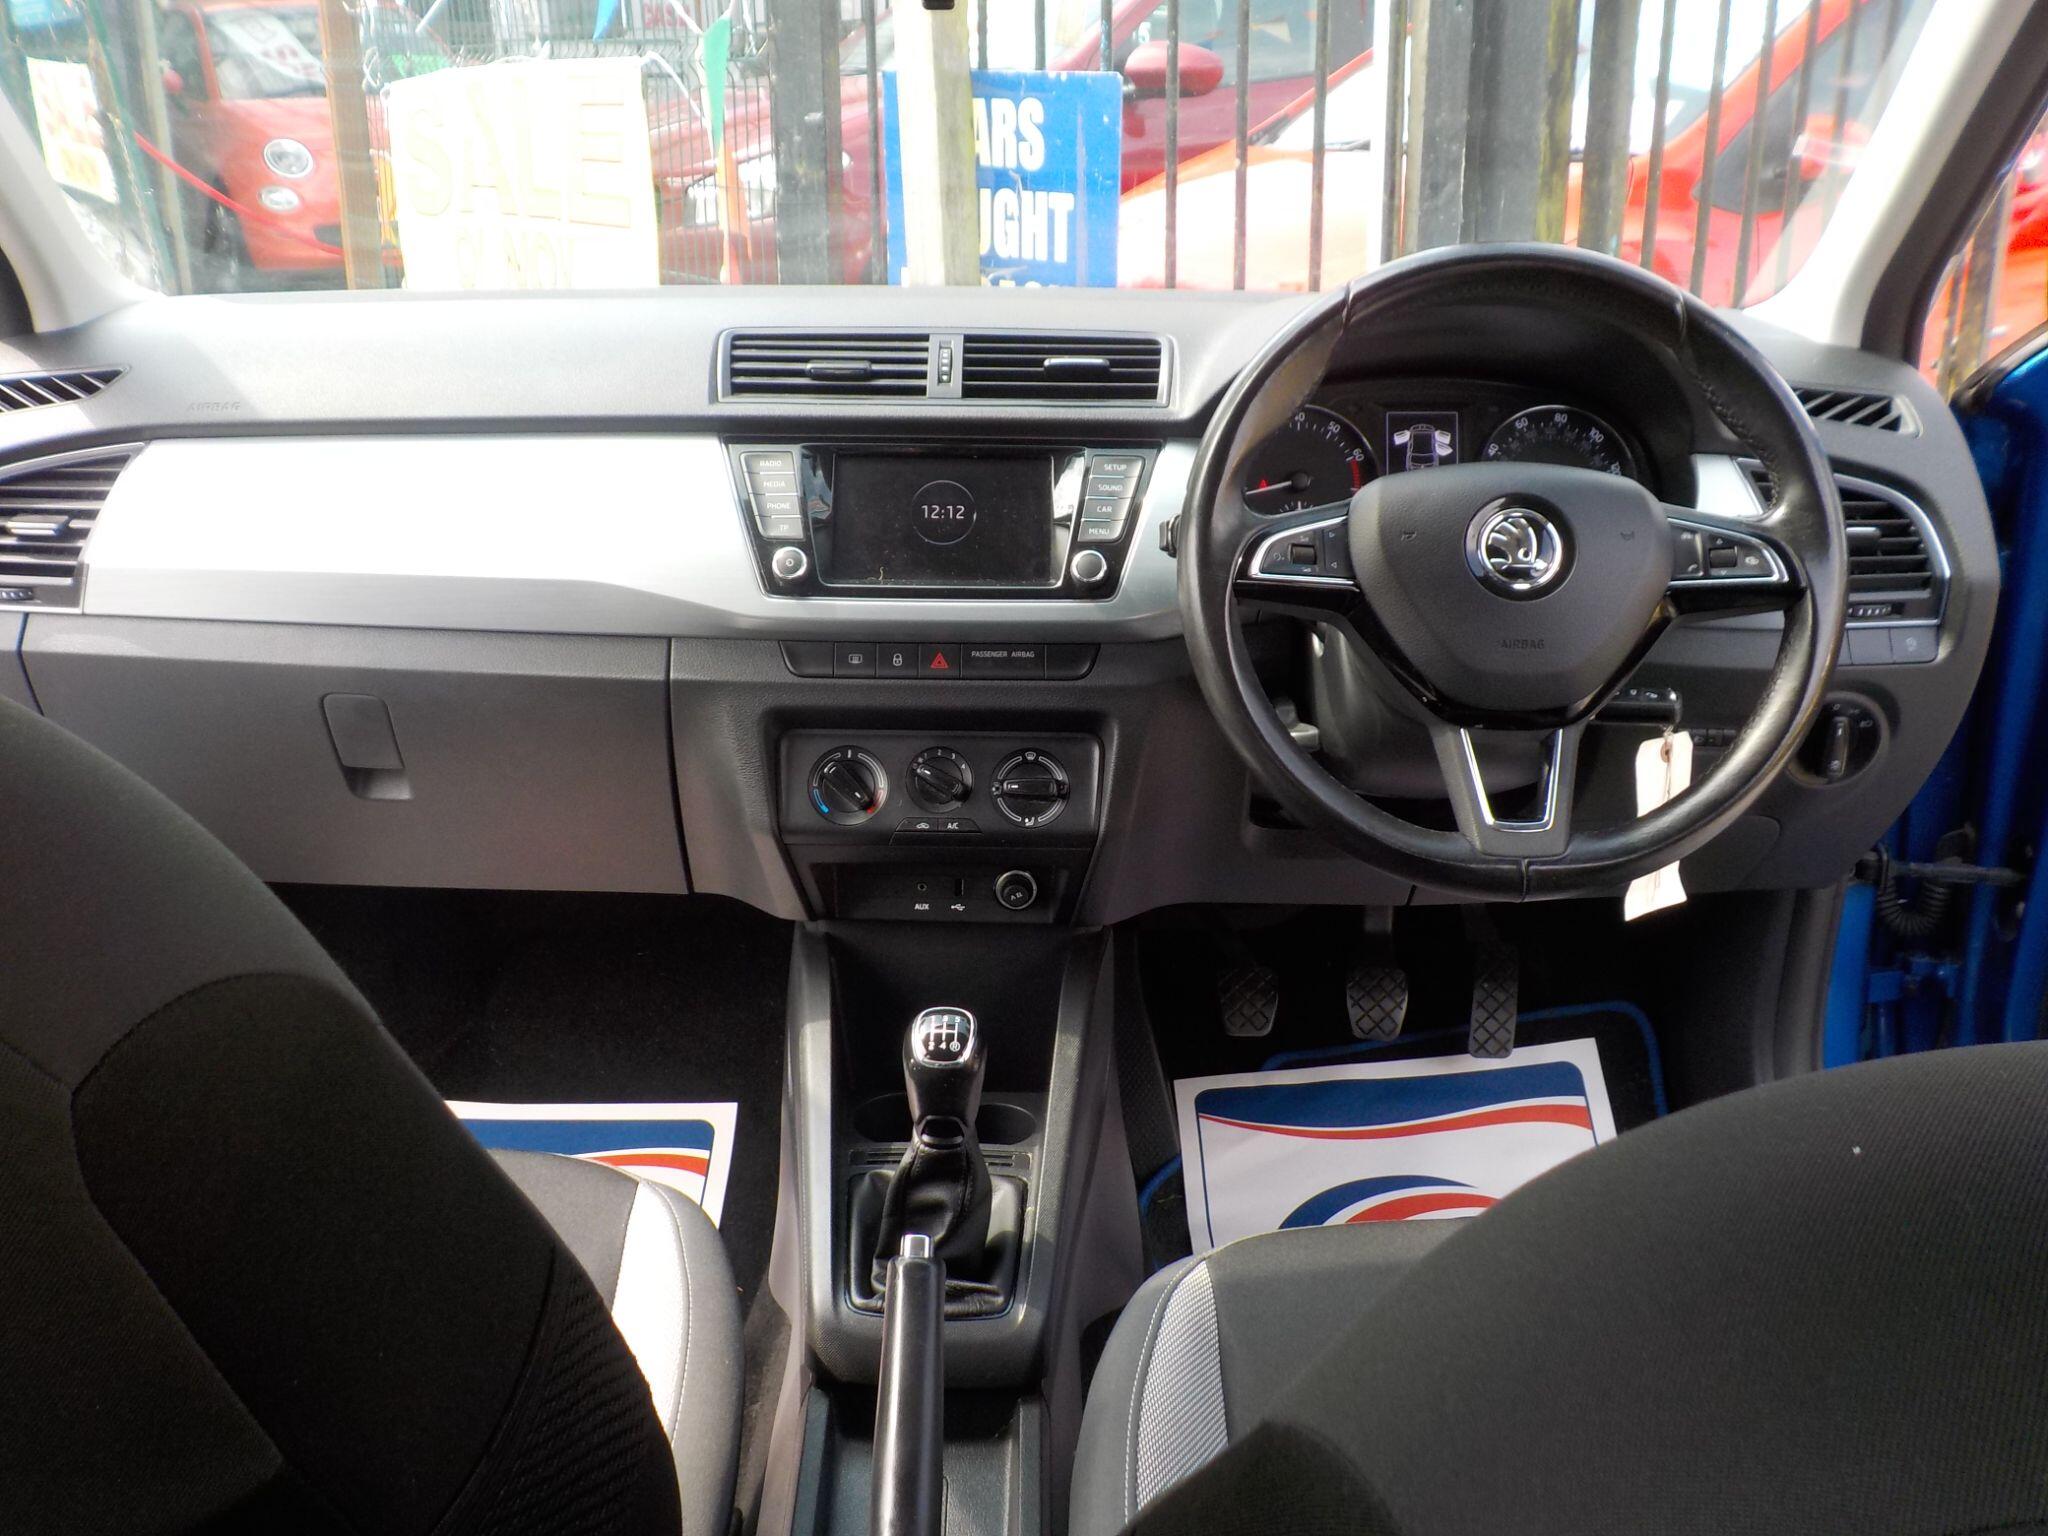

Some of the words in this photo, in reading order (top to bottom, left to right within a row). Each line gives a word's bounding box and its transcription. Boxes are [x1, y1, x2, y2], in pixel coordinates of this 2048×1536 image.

[972, 97, 1046, 172] ARS
[406, 76, 631, 229] SALE
[979, 188, 1075, 263] UGHT
[186, 401, 241, 411] AIRBAG
[1515, 417, 1529, 430] 60
[1554, 412, 1568, 424] 80
[1328, 421, 1341, 433] 50
[1588, 427, 1605, 443] 100
[1352, 447, 1365, 461] 60
[1487, 443, 1500, 457] 40
[921, 505, 965, 519] 12:12
[1096, 505, 1113, 513] CAR
[1501, 639, 1545, 649] AIRBAG
[971, 650, 1008, 658] PASSENGER
[1011, 650, 1035, 658] AIRBAG
[947, 822, 959, 830] A/C
[914, 903, 930, 911] AUX
[928, 1041, 935, 1051] 2
[938, 1041, 946, 1050] 4
